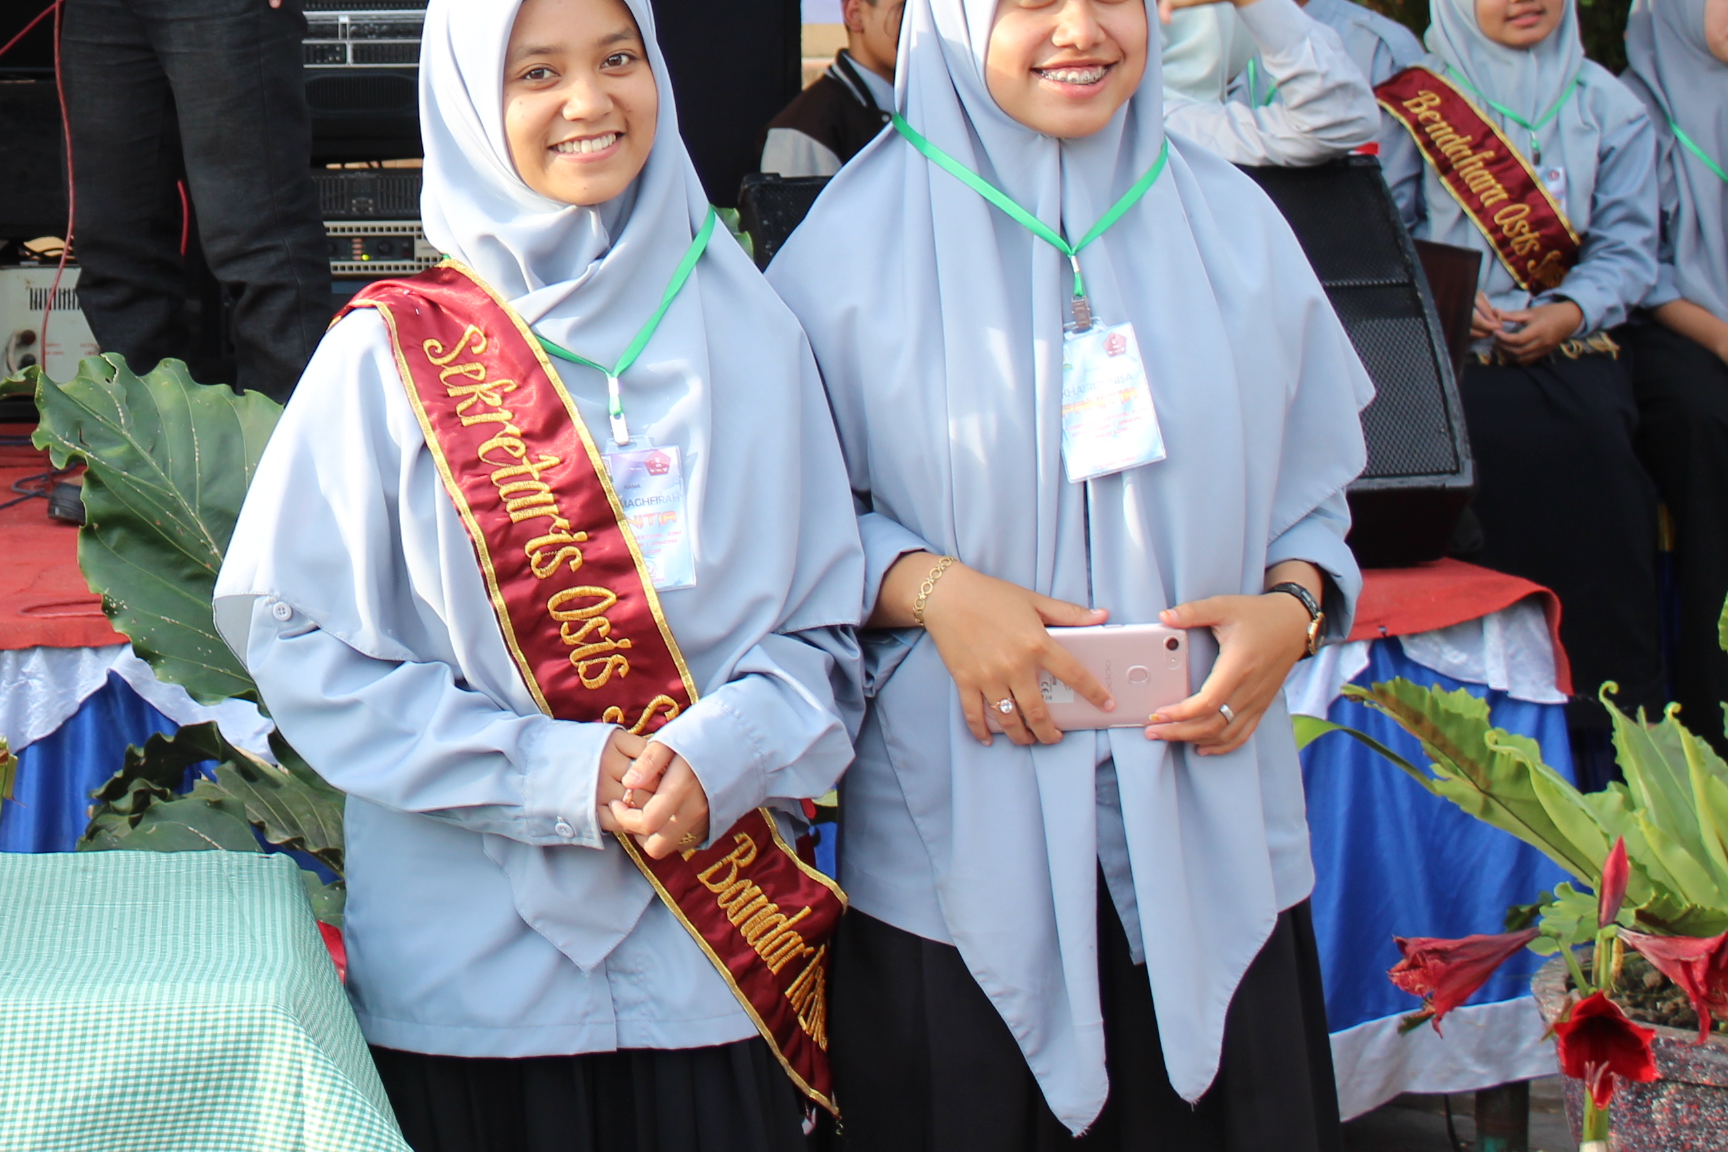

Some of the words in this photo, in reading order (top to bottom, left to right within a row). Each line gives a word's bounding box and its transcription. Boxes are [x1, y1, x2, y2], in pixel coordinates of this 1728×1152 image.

[1401, 90, 1509, 208] Bendahara
[1063, 373, 1134, 398] KHAIRUNISA
[422, 324, 589, 580] Sekretaris
[546, 585, 633, 690] Osis
[625, 510, 678, 529] NITIA
[696, 831, 816, 977] Bandar
